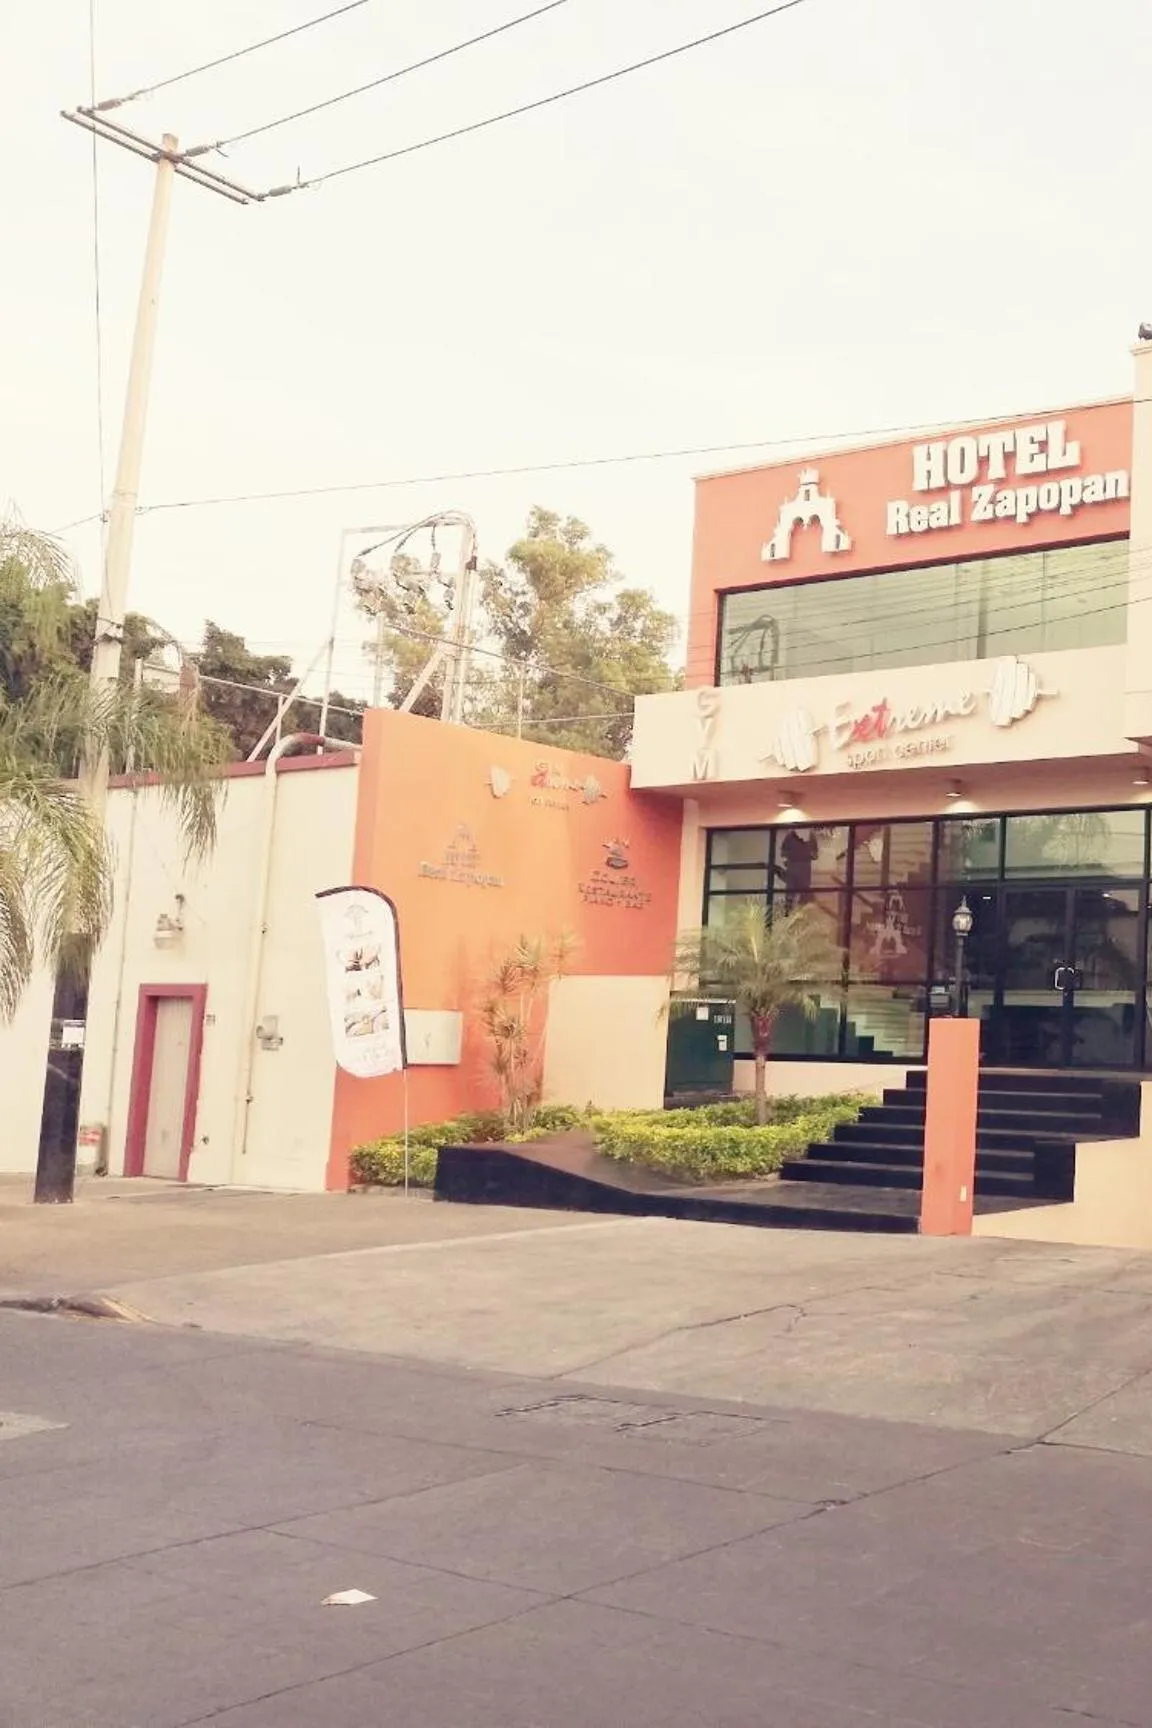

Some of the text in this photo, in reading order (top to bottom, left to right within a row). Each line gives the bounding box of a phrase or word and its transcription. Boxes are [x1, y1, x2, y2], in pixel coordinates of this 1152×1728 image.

[912, 419, 1081, 491] HOTEL
[886, 469, 1130, 535] Real Zapopan
[692, 690, 722, 781] GYM
[828, 687, 976, 750] Extreme
